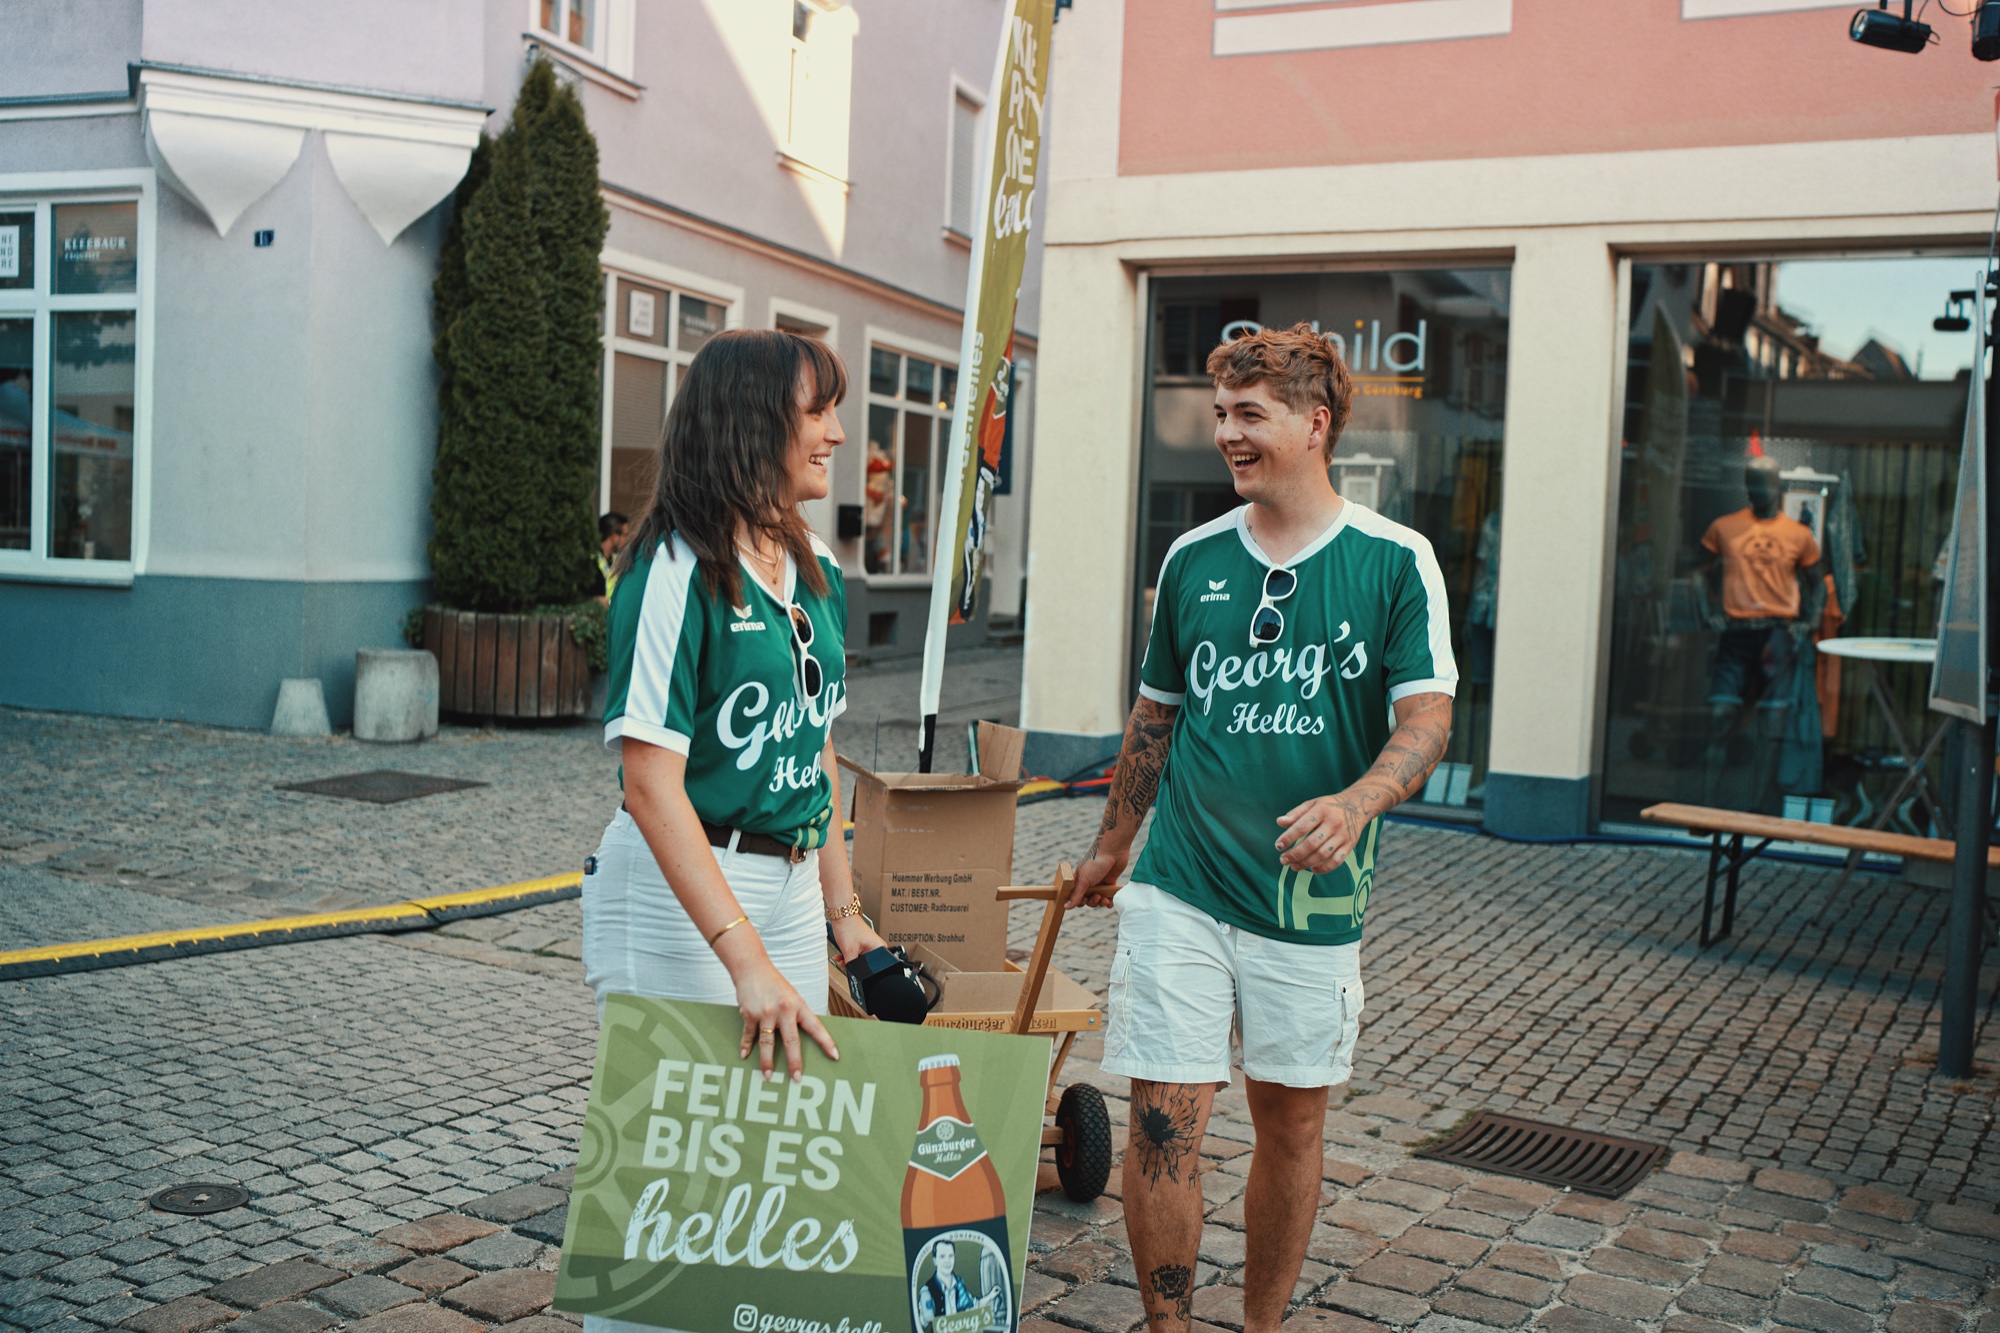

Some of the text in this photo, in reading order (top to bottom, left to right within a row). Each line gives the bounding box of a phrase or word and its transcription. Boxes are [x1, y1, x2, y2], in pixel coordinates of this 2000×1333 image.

[1200, 592, 1230, 602] erima
[730, 620, 766, 632] erima
[1190, 620, 1368, 717] Georg's
[1227, 702, 1325, 735] Helles
[892, 873, 972, 885] Huemmer Werbung GmbH
[891, 888, 907, 897] MAT.
[911, 889, 941, 898] BEST.NR.
[890, 903, 969, 912] CUSTOMER: Radbrauerei
[889, 933, 965, 943] DESCRIPTION: Strohhut
[651, 1058, 877, 1136] FEIERN
[642, 1115, 844, 1191] BIS ES
[917, 1138, 976, 1155] Günzburger
[624, 1177, 859, 1273] helles
